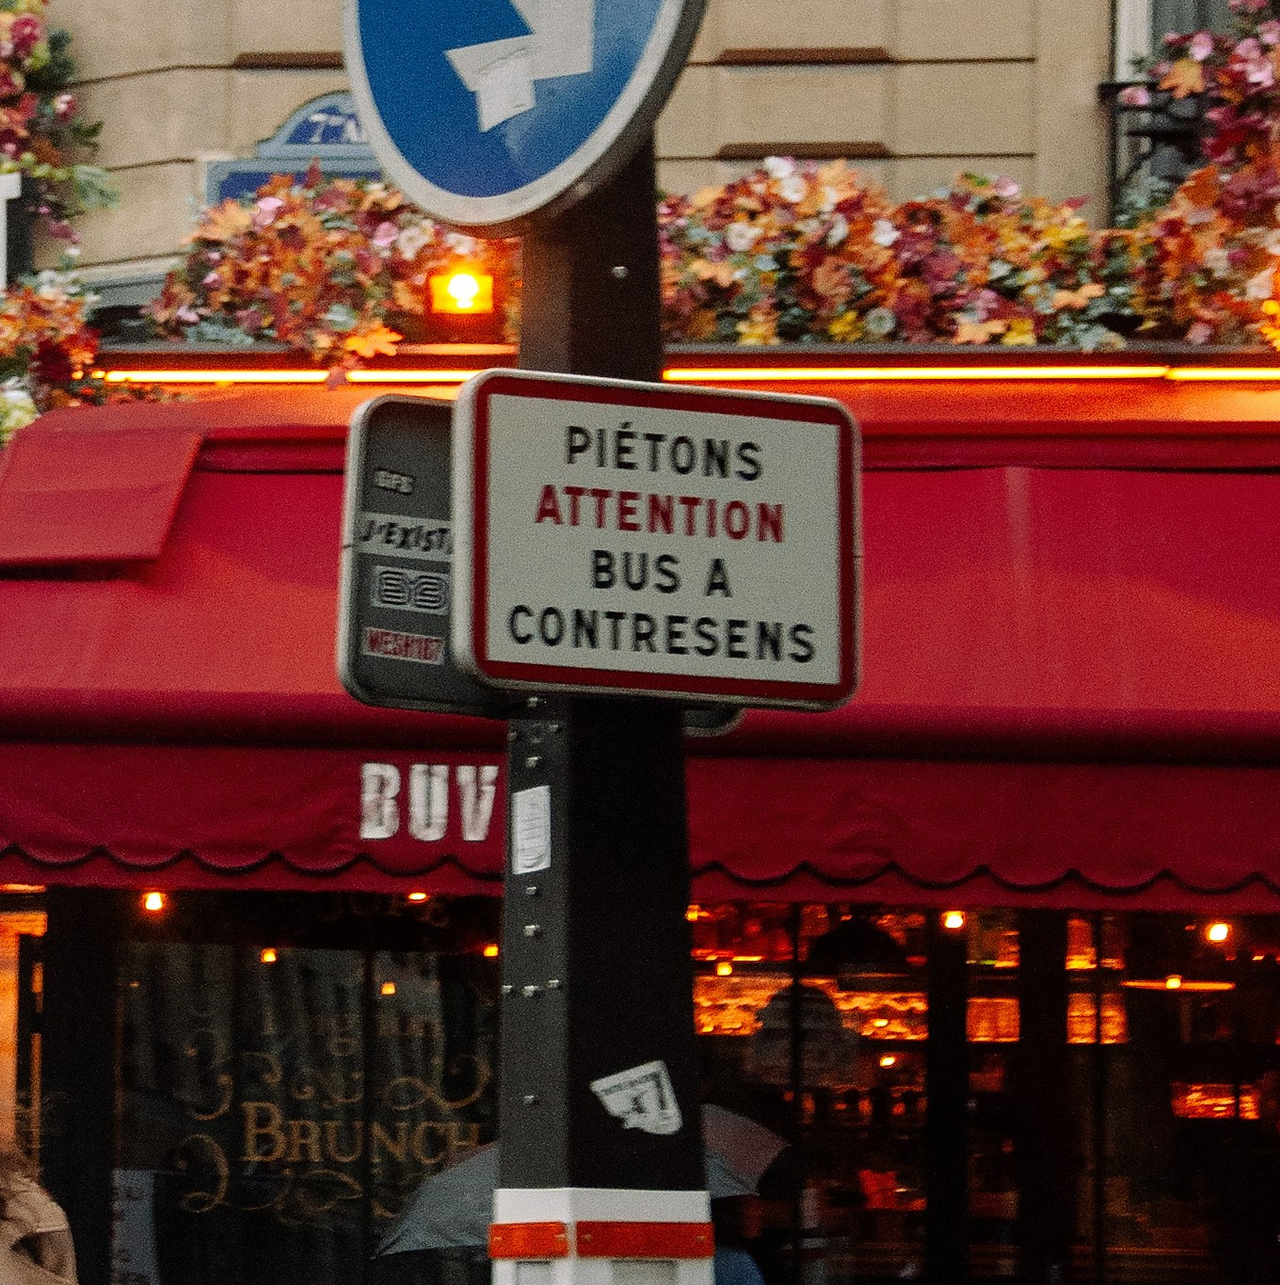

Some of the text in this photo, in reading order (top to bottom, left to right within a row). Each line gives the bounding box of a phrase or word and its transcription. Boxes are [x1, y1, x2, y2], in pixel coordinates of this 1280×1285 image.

[565, 421, 763, 482] PIÉTONS
[535, 484, 786, 544] ATTENTION
[591, 550, 734, 598] BUS A
[508, 605, 816, 665] CONTRESENS
